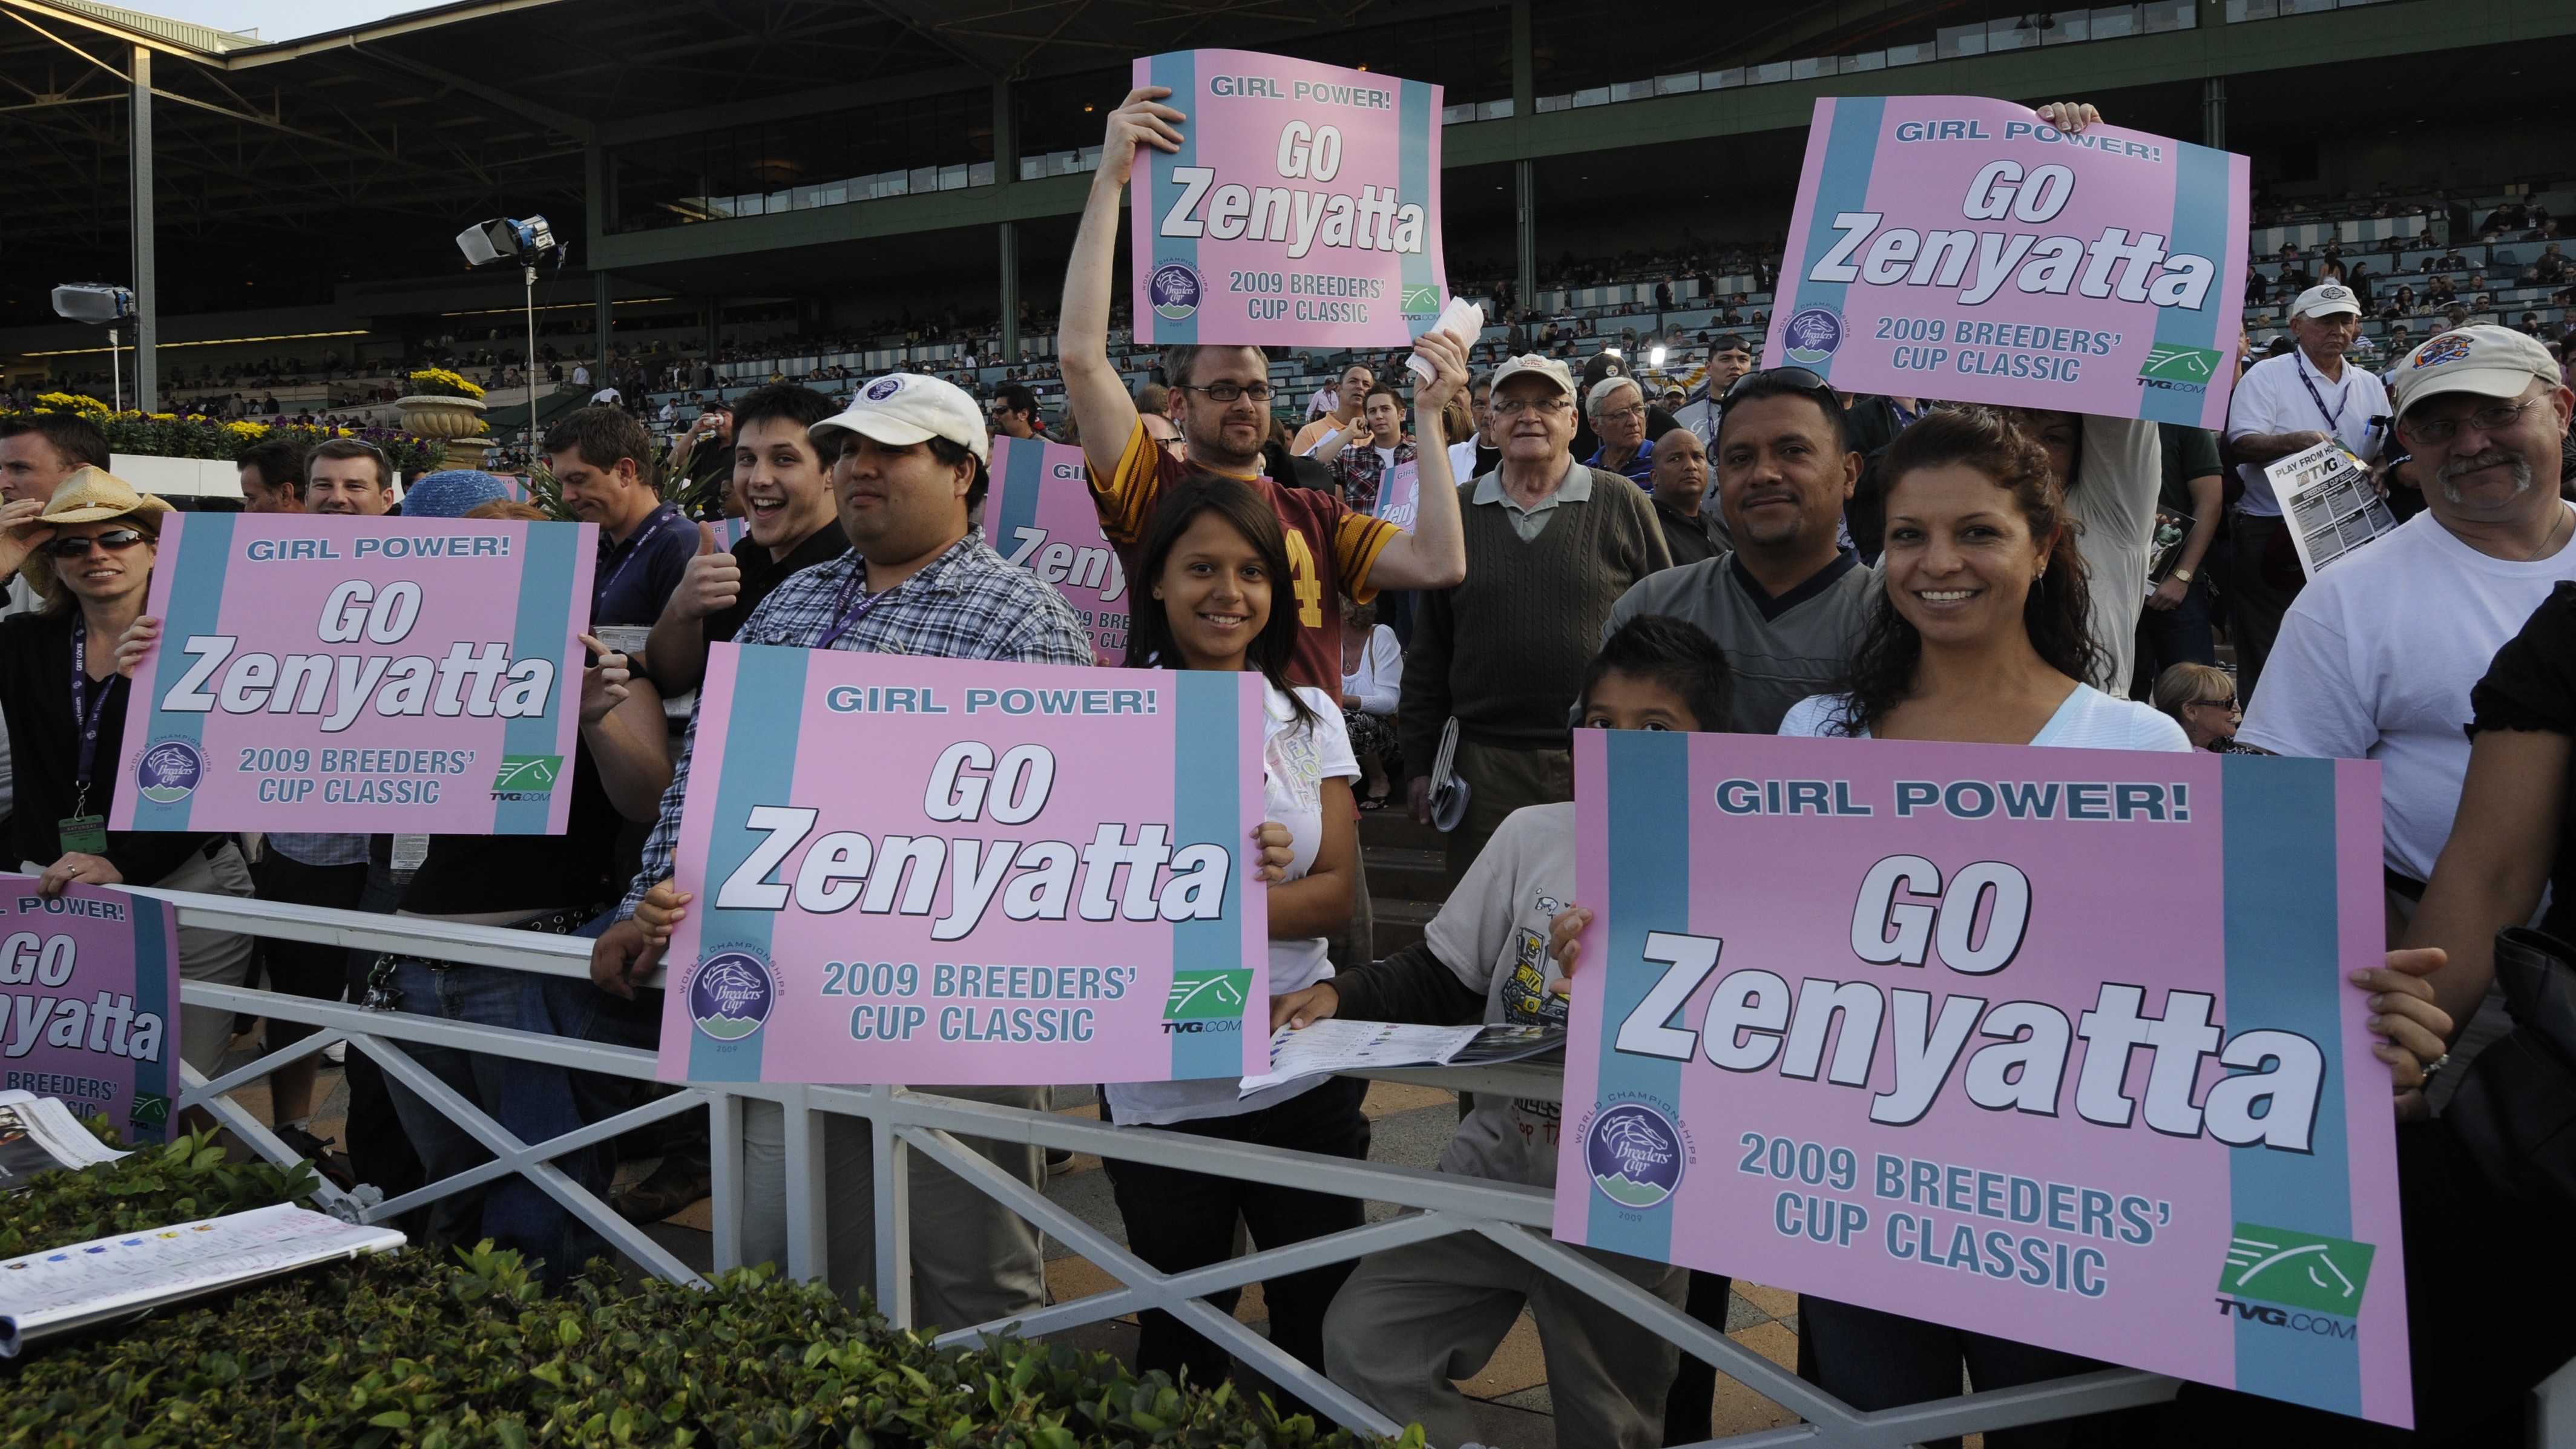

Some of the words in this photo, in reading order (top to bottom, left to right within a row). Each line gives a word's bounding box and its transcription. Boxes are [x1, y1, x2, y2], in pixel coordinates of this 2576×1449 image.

[1210, 76, 1285, 99] GIRL
[1293, 80, 1392, 111] POWER!
[1276, 120, 1342, 182] GO
[1896, 119, 1991, 143] GIRL
[2004, 120, 2162, 162] POWER!
[1160, 166, 1425, 258] Zenyatta
[1962, 159, 2075, 224] GO
[1809, 212, 2216, 311] Zenyatta
[1229, 271, 1283, 293] 2009
[1290, 273, 1385, 299] BREEDERS'
[1247, 298, 1287, 320] CUP
[1295, 300, 1368, 323] CLASSIC
[1875, 317, 1946, 341] 2009
[1954, 321, 2122, 357] BREEDERS'
[1893, 346, 1949, 371] CUP
[1956, 349, 2081, 383] CLASSIC
[2136, 378, 2207, 395] TVG.COM
[2275, 462, 2298, 478] PLAY
[2299, 450, 2324, 467] FROM
[246, 538, 341, 562] GIRL
[354, 535, 511, 559] POWER!
[317, 579, 423, 645] GO
[160, 634, 556, 733] Zenyatta
[826, 685, 948, 715] GIRL
[964, 687, 1158, 716] POWER!
[238, 748, 310, 774] 2009
[319, 748, 476, 775] BREEDERS'
[258, 778, 314, 803] CUP
[323, 779, 441, 805] CLASSIC
[490, 792, 551, 802] TVG.COM
[923, 740, 1056, 825] GO
[1714, 777, 1873, 816] GIRL
[1893, 779, 2192, 823] POWER!
[715, 805, 1230, 941] Zenyatta
[17, 896, 126, 922] POWER!
[1848, 852, 2032, 976] GO
[0, 930, 77, 988] GO
[679, 954, 704, 994] WORLD
[709, 942, 784, 996] CHAMPIONSHIPS
[820, 961, 918, 997] 2009
[932, 962, 1137, 1002] BREEDERS'
[849, 1004, 926, 1042] CUP
[938, 1005, 1095, 1043] CLASSIC
[1161, 1020, 1242, 1034] TVG.COM
[1614, 928, 2326, 1157] Zenyatta
[6, 1070, 118, 1102] BREEDERS'
[1575, 1101, 1602, 1144] WORLD
[1608, 1091, 1697, 1165] CHAMPIONSHIPS
[1623, 1158, 1651, 1177] Cup
[1738, 1131, 1857, 1191] 2009
[1873, 1150, 2171, 1247] BREEDERS'
[1618, 1212, 1642, 1221] 2009
[1773, 1191, 1870, 1249] CUP
[1885, 1211, 2109, 1299] CLASSIC
[2215, 1296, 2359, 1343] TVG.COM
